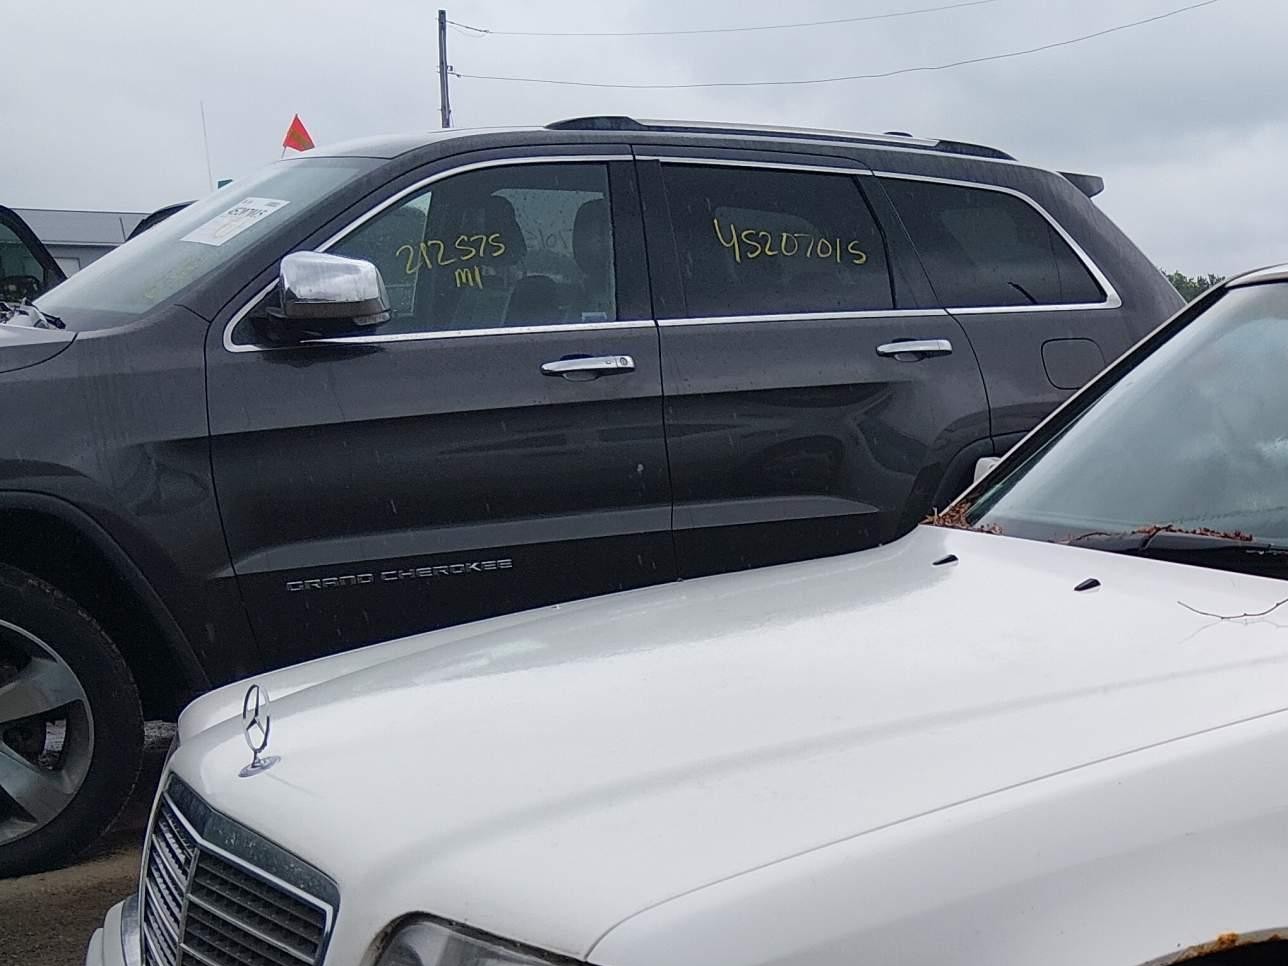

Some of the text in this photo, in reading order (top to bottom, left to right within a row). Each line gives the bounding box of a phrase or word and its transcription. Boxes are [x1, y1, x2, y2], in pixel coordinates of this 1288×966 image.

[714, 218, 867, 264] 45207015
[287, 559, 512, 591] GRAND CHEROKEE
